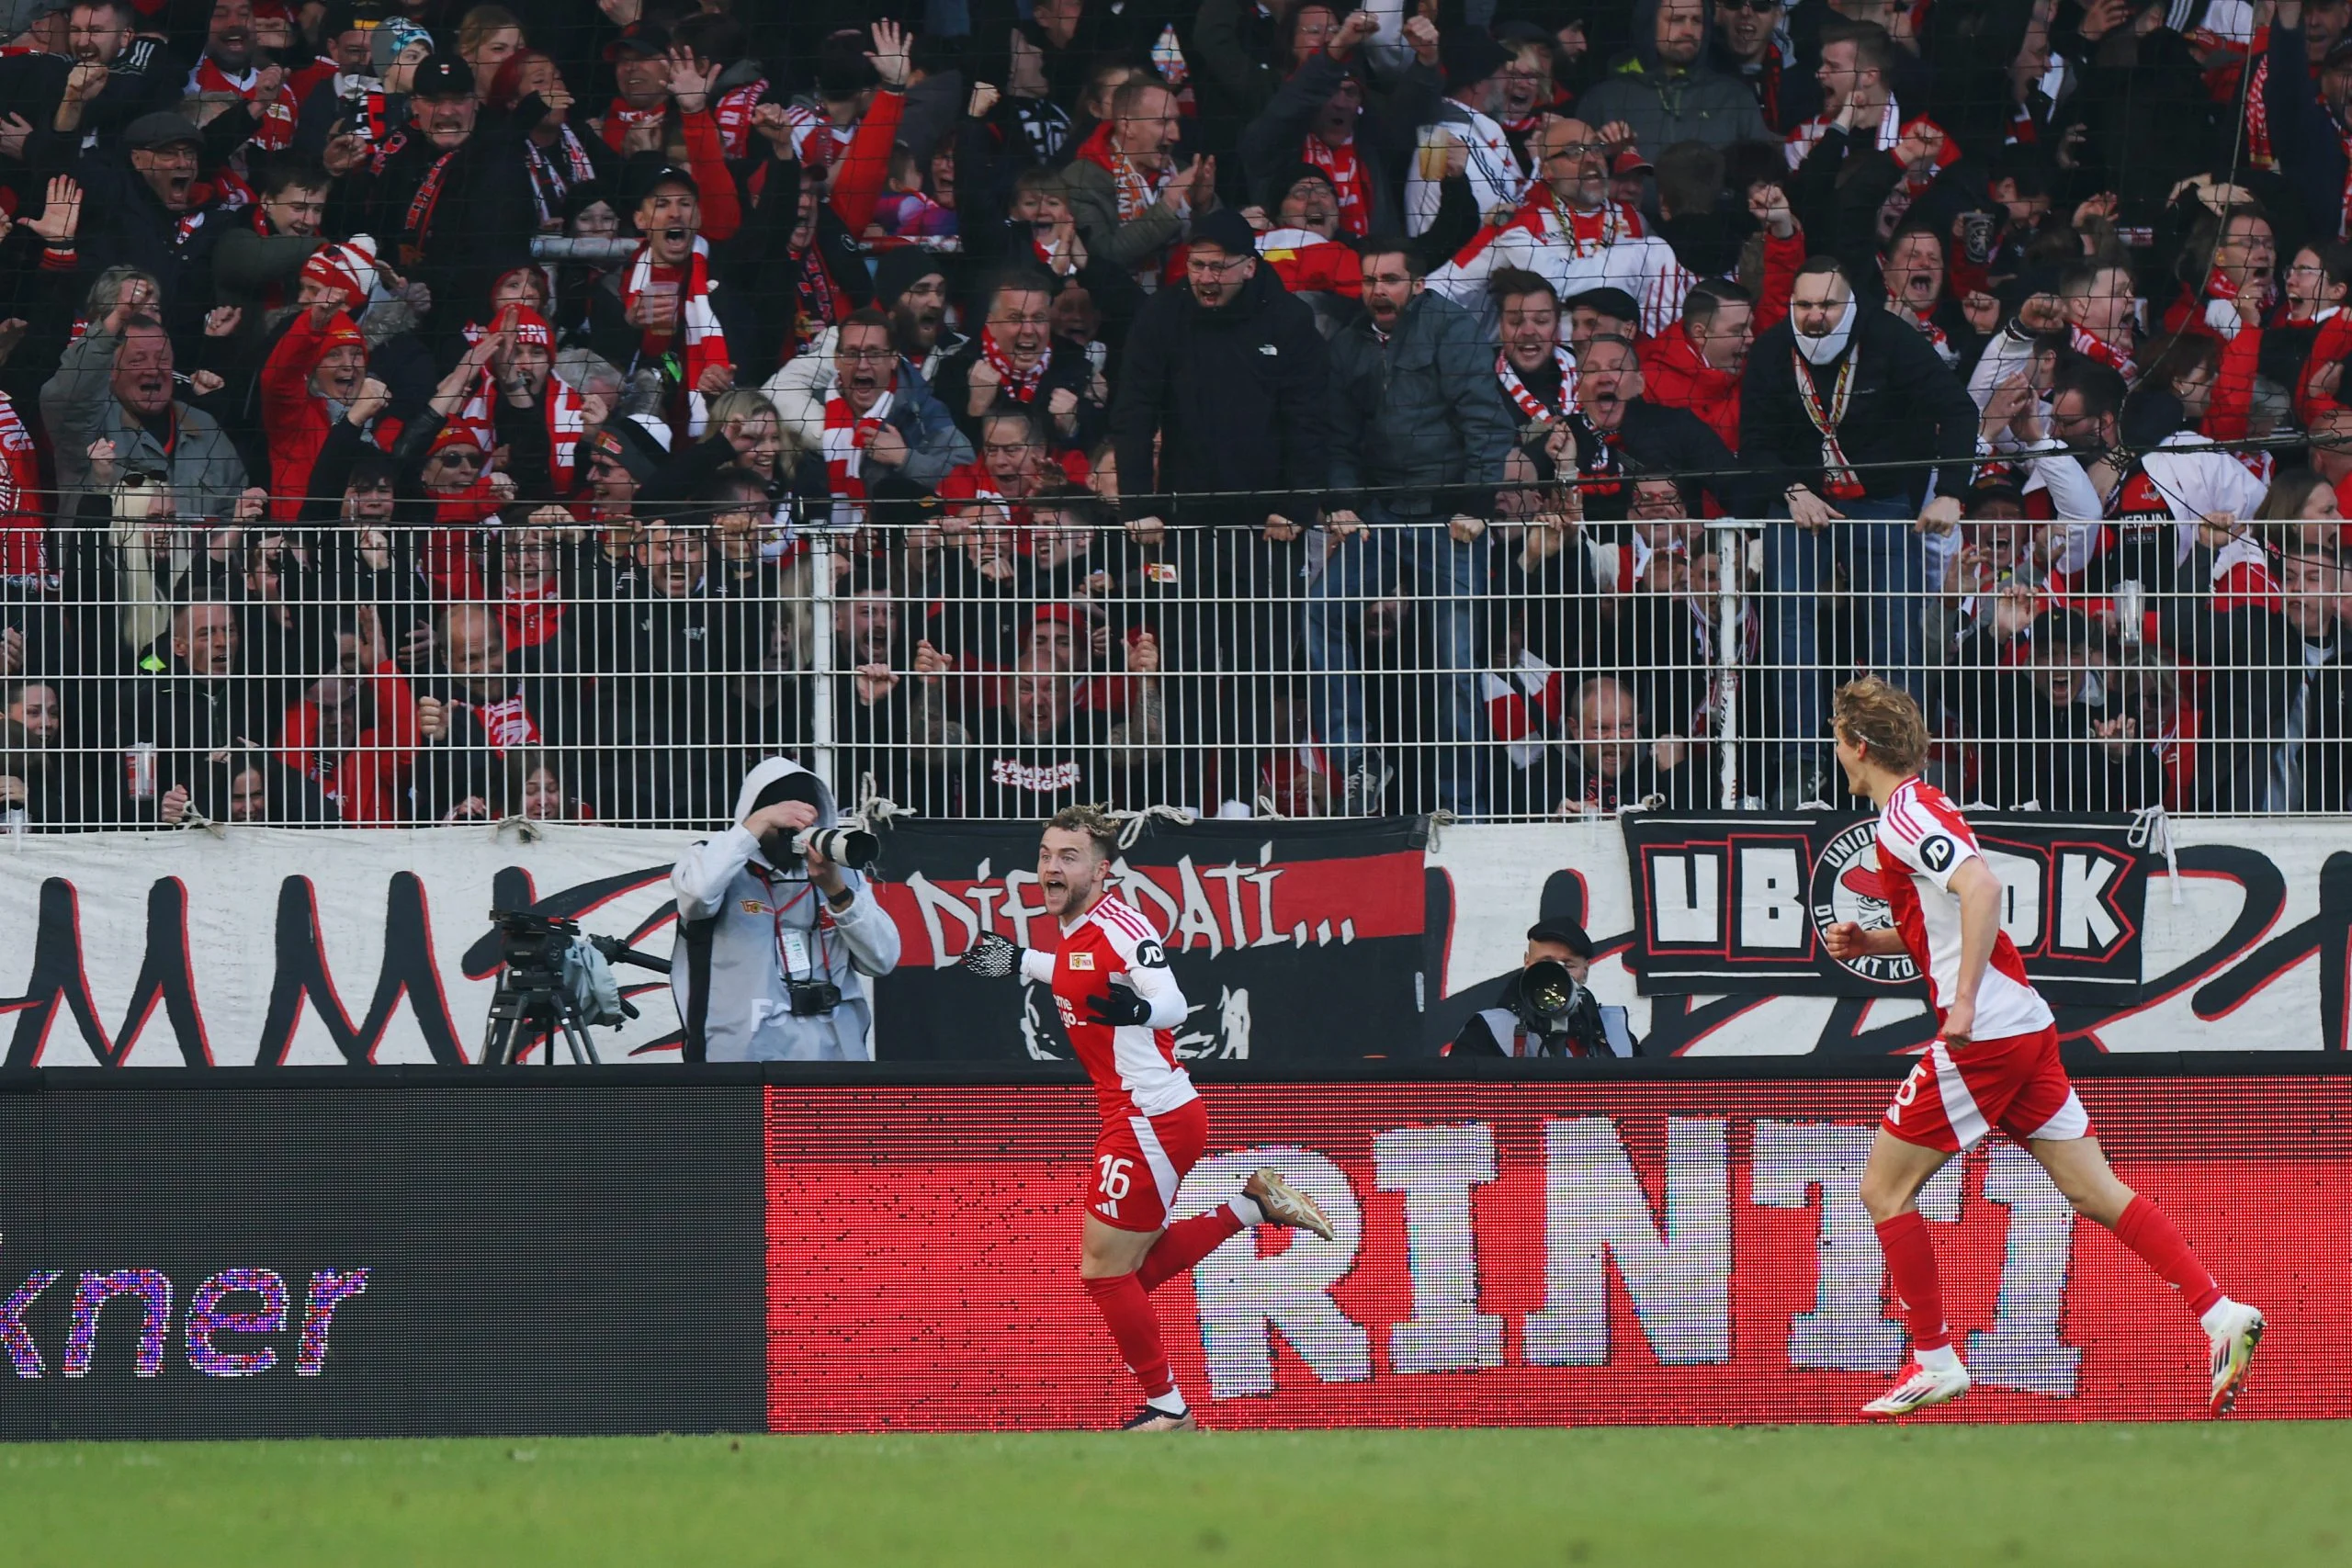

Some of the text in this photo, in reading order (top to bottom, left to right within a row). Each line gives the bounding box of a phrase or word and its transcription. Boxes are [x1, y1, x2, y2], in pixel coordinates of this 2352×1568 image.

[1926, 839, 1950, 871] JD
[1654, 847, 1804, 949] UB
[1143, 945, 1164, 966] JD
[1098, 1154, 1134, 1200] 16
[1183, 1116, 2083, 1400] RINTI
